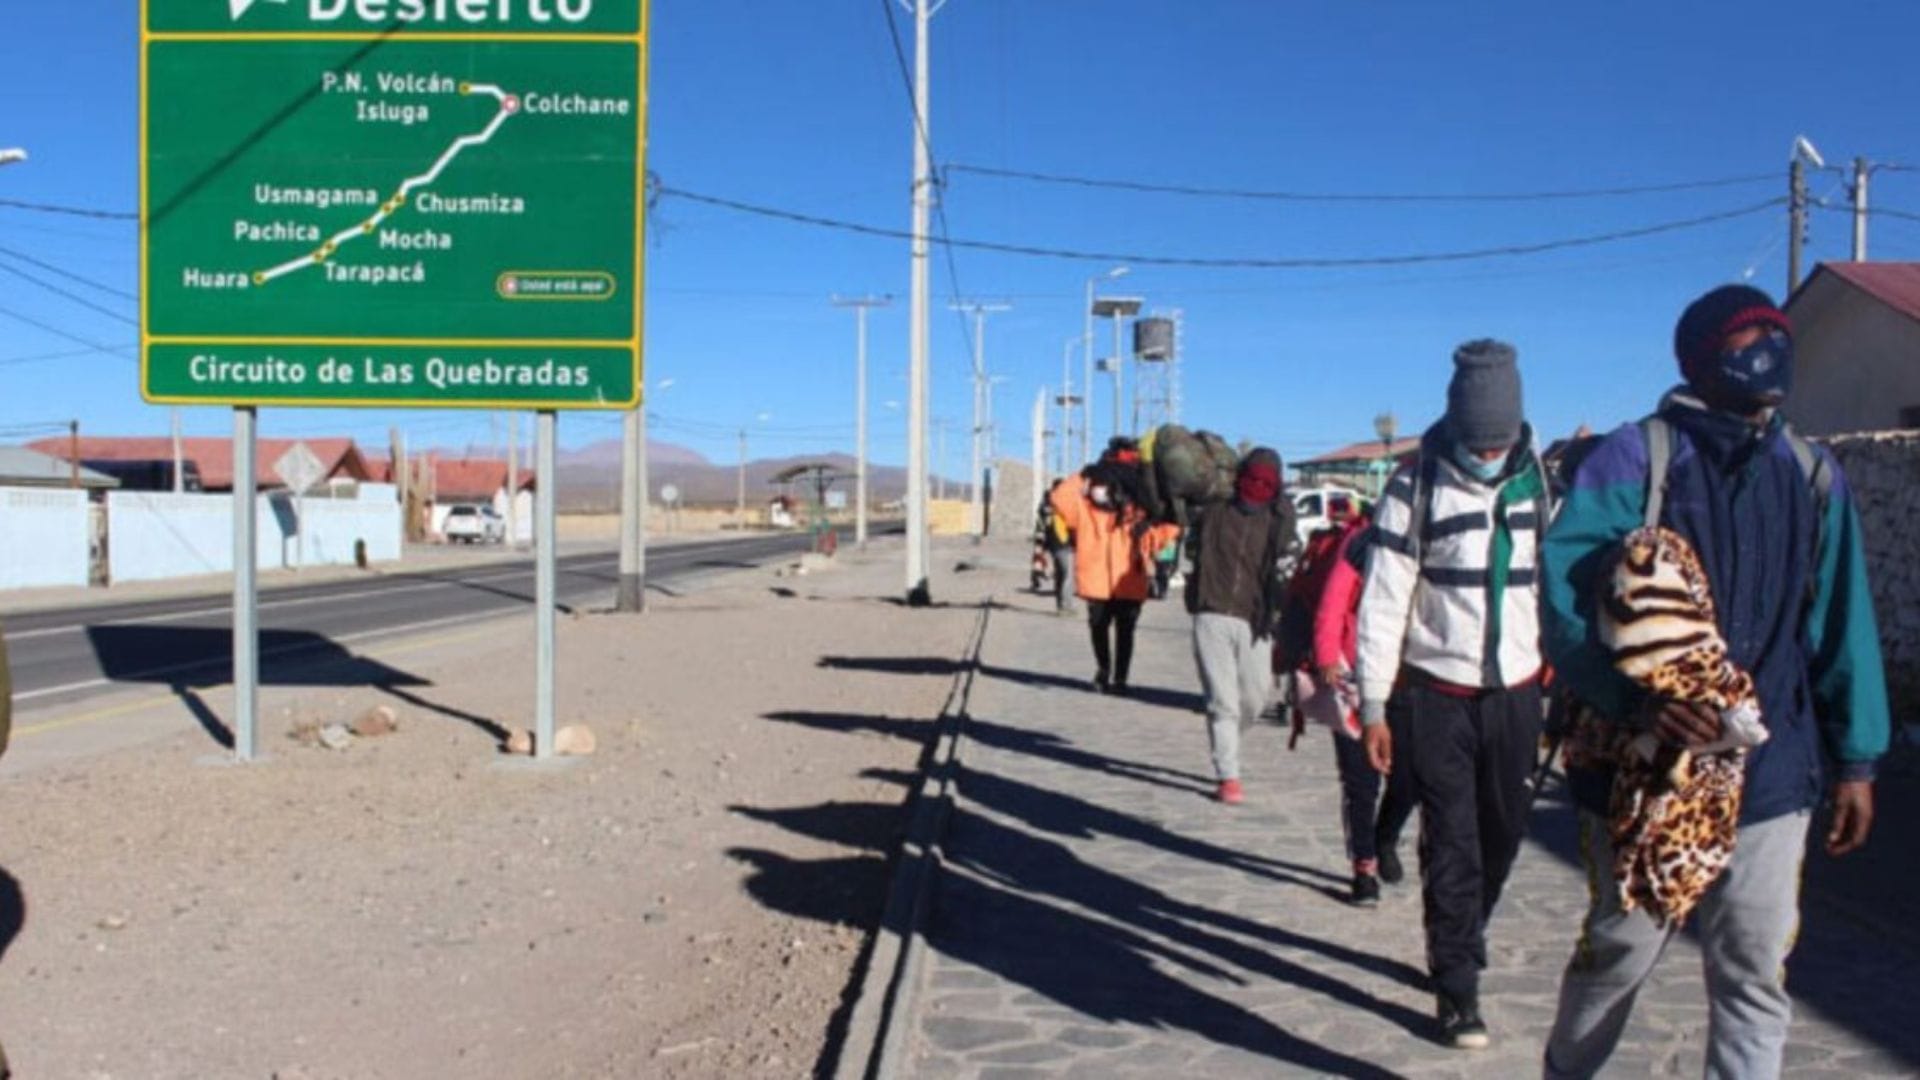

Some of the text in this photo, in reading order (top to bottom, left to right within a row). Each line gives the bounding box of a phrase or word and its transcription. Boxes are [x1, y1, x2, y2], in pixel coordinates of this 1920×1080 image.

[324, 72, 455, 93] P.N. Volcán
[357, 101, 429, 125] Isluga
[524, 93, 630, 115] Colchane
[255, 185, 378, 208] Usmagama
[416, 193, 525, 214] Chusmiza
[234, 221, 320, 242] Pachica
[379, 230, 452, 250] Mocha
[183, 269, 249, 289] Huara
[324, 260, 425, 284] Tarapacá
[190, 355, 589, 389] Circuito de Las Quebradas
